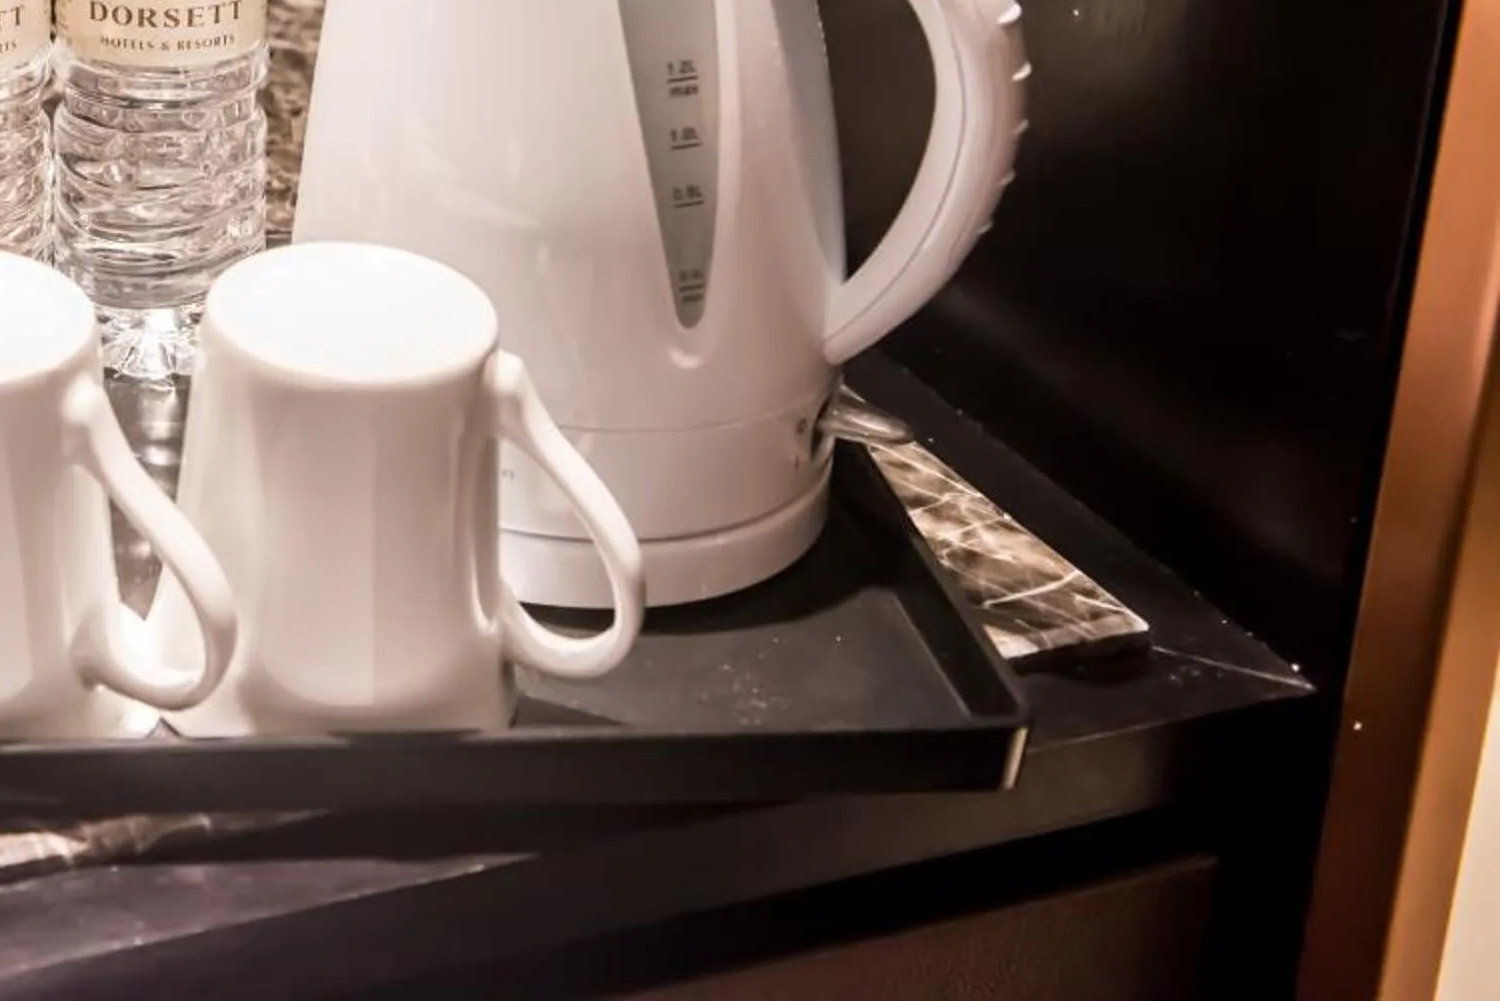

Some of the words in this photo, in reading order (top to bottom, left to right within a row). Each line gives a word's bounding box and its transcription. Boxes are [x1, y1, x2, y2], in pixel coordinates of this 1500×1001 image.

[100, 35, 155, 51] HOTELS
[161, 40, 171, 51] &
[177, 33, 235, 51] RESORTS
